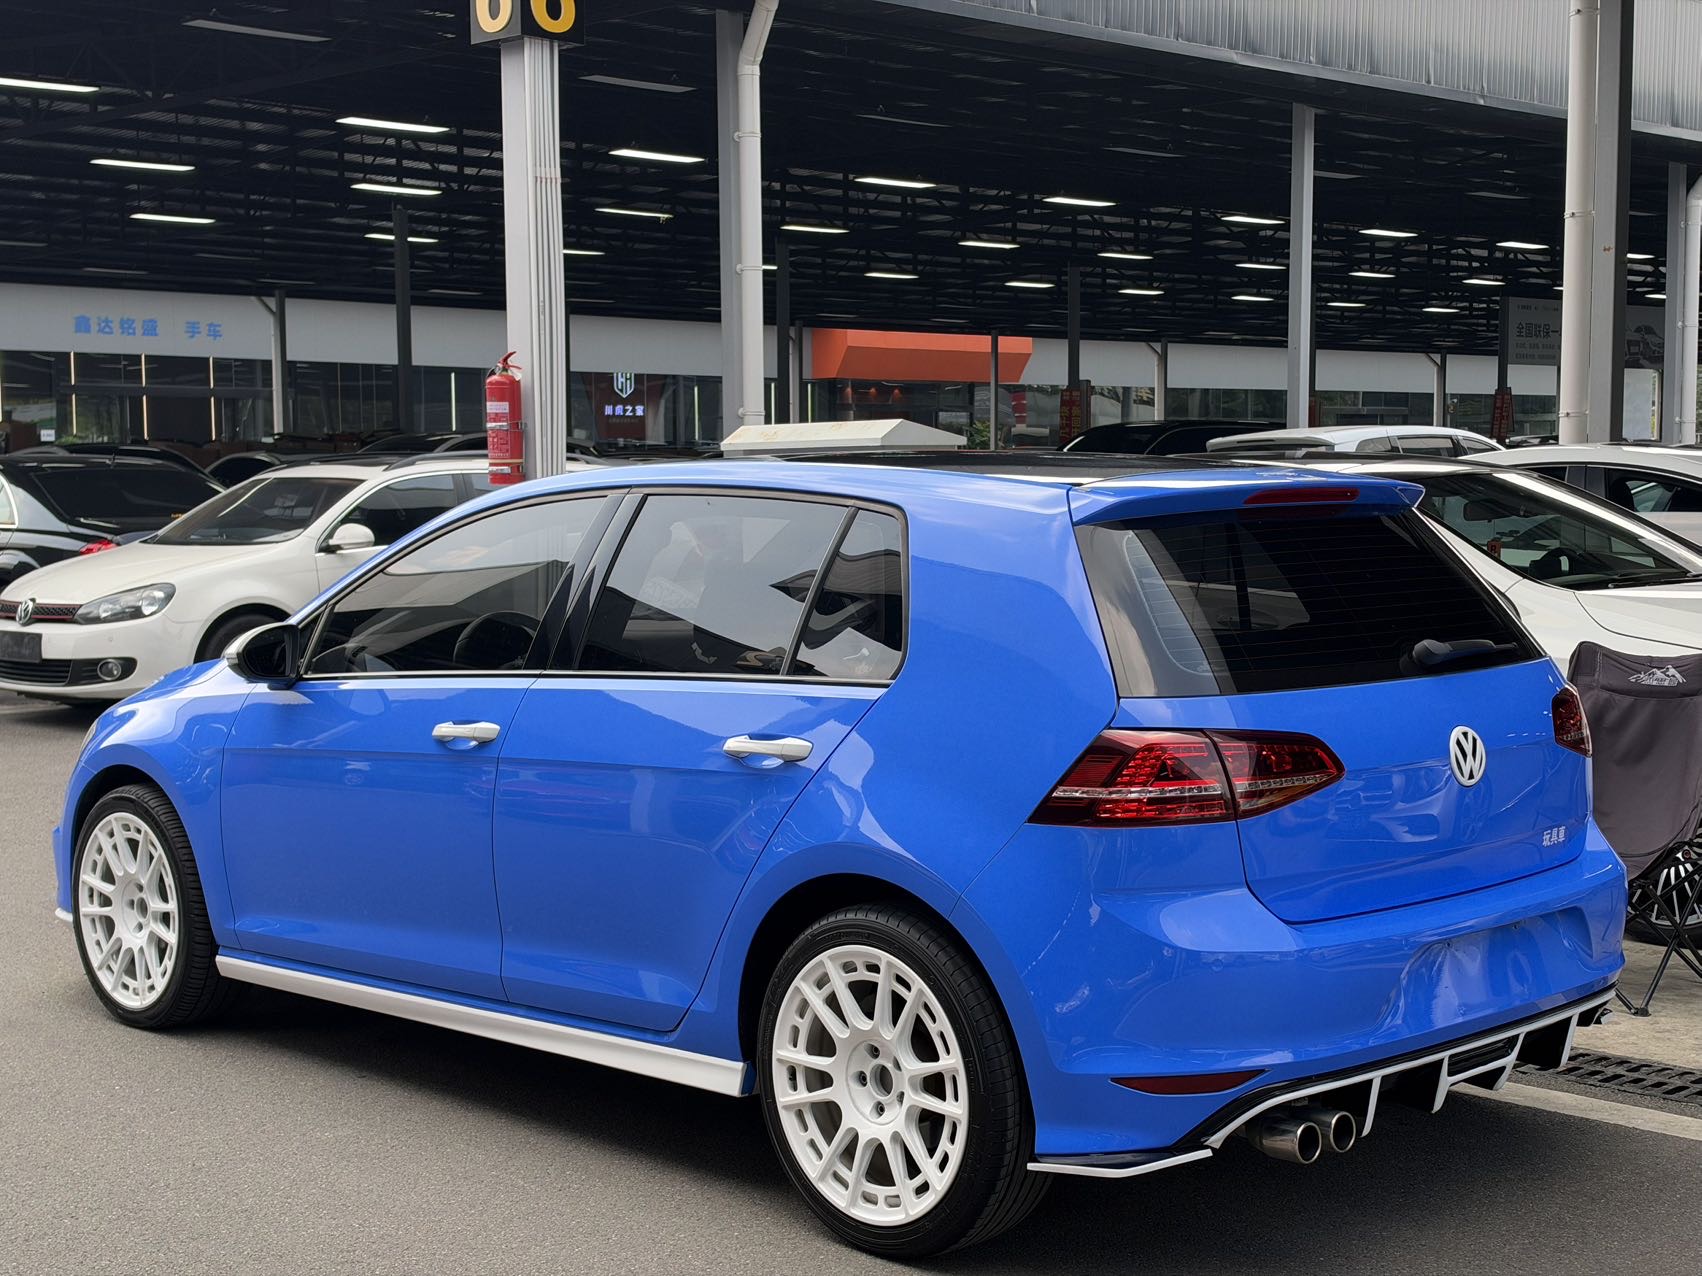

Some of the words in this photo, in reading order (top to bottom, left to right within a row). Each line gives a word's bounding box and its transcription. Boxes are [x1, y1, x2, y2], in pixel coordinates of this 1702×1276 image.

[1515, 321, 1562, 339] 全国联保一
[1450, 725, 1486, 787] VW
